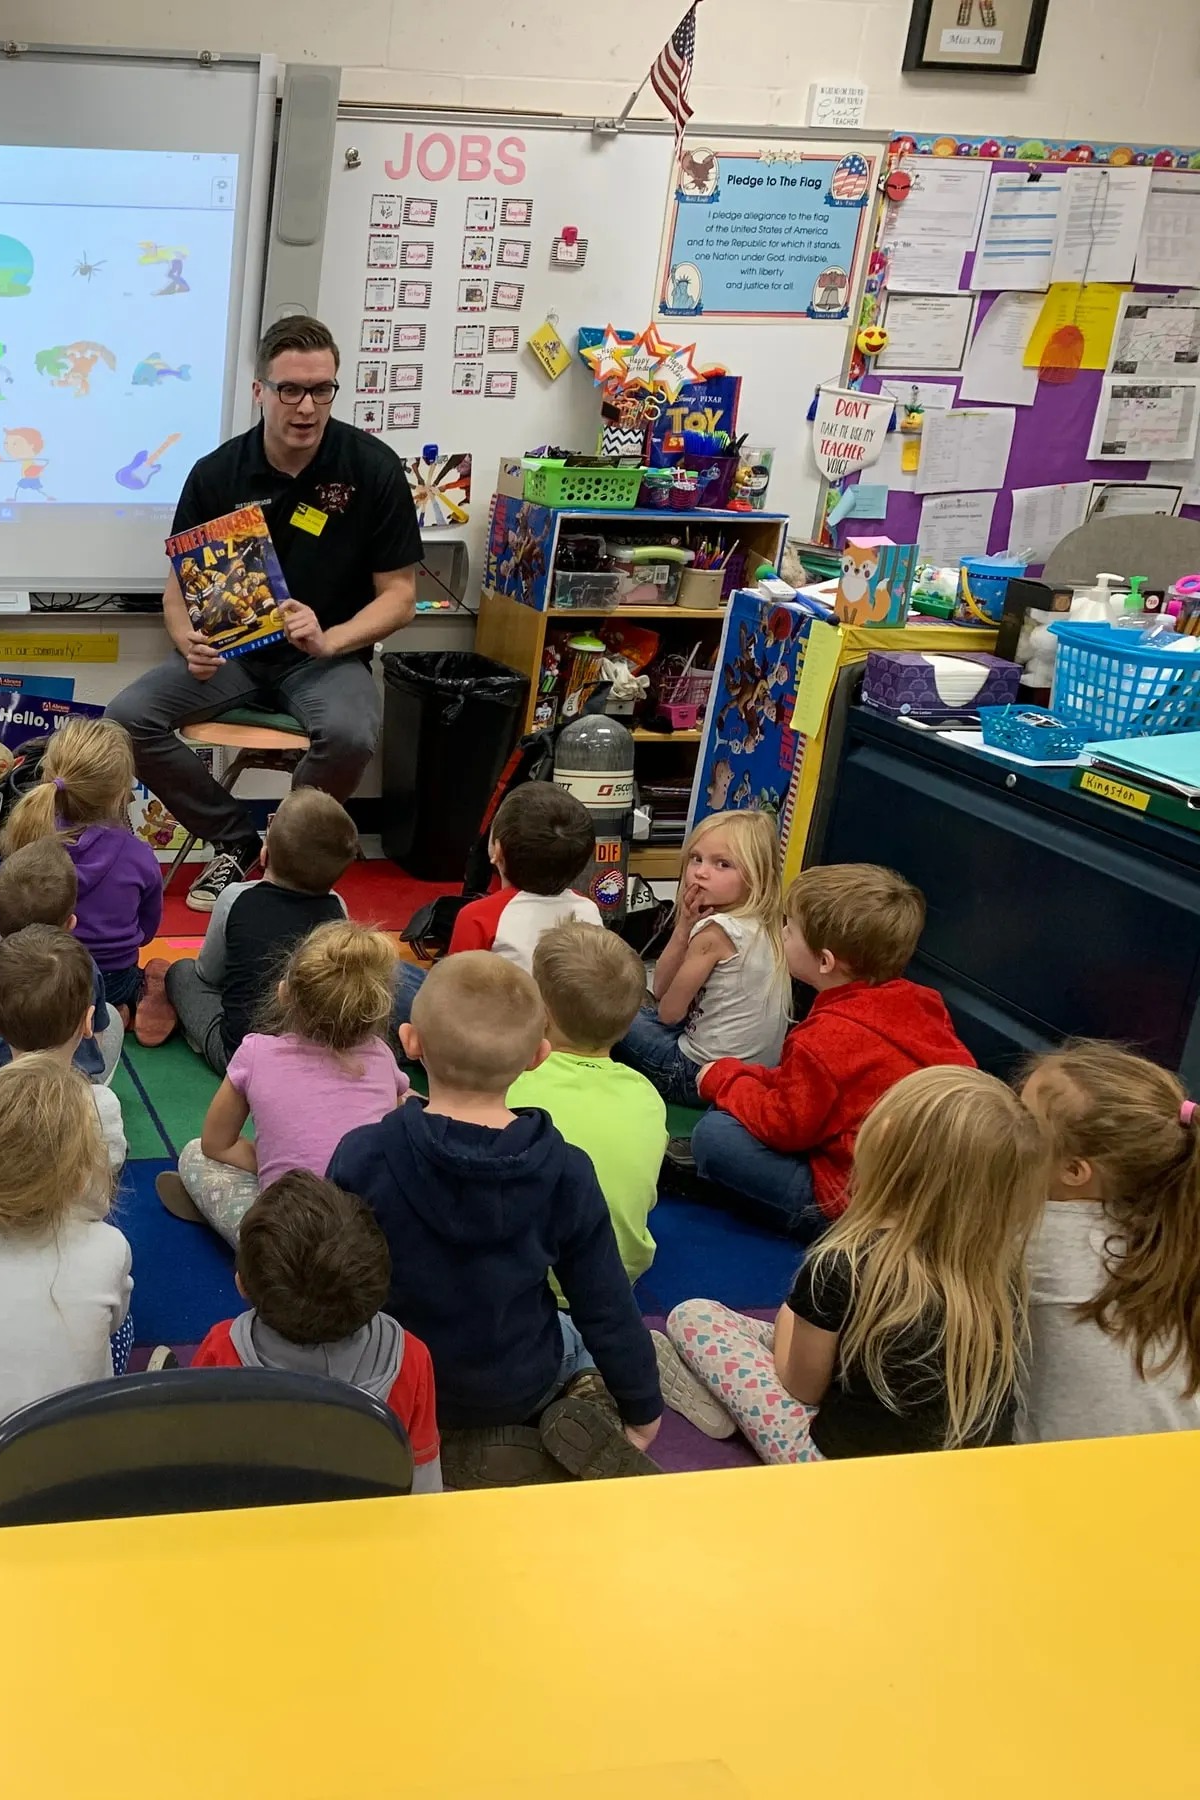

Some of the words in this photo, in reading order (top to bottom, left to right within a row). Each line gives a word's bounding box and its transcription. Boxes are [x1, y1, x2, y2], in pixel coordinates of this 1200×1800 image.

[946, 34, 971, 45] Miss
[832, 117, 859, 126] TEACHER
[384, 132, 526, 185] JOBS
[727, 174, 764, 187] Pledge
[766, 175, 777, 186] to
[780, 175, 797, 187] The
[800, 176, 822, 189] Flag
[712, 210, 742, 221] pledge
[743, 211, 786, 222] allegiance
[788, 212, 797, 221] to
[798, 212, 812, 221] the
[813, 212, 830, 223] flag
[705, 224, 714, 233] of
[715, 224, 729, 233] the
[730, 225, 757, 235] United
[758, 225, 782, 235] States
[784, 226, 793, 235] of
[794, 226, 828, 235] America
[686, 238, 704, 247] and
[705, 239, 714, 247] to
[716, 239, 730, 247] the
[731, 239, 767, 249] Republic
[768, 240, 779, 248] for
[780, 240, 805, 249] which
[806, 240, 813, 249] it
[712, 252, 740, 261] Nation
[741, 253, 765, 262] under
[740, 267, 757, 276] with
[758, 267, 784, 278] liberty
[726, 281, 742, 289] and
[743, 281, 770, 291] justice
[771, 282, 782, 290] for
[629, 355, 650, 366] Happy
[700, 395, 722, 404] PIXAR
[835, 398, 871, 420] DON'T
[666, 407, 724, 434] TOY
[820, 421, 839, 437] MAKE
[839, 423, 851, 439] ME
[852, 425, 863, 441] USE
[864, 427, 876, 443] MY
[820, 438, 866, 461] TEACHER
[826, 457, 849, 475] VOICE
[203, 546, 217, 568] A
[216, 549, 225, 557] to
[223, 538, 238, 559] Z
[4, 643, 13, 655] in
[15, 645, 27, 655] our
[33, 642, 83, 660] community?
[0, 706, 50, 730] Hello,
[1086, 775, 1135, 802] Kingston
